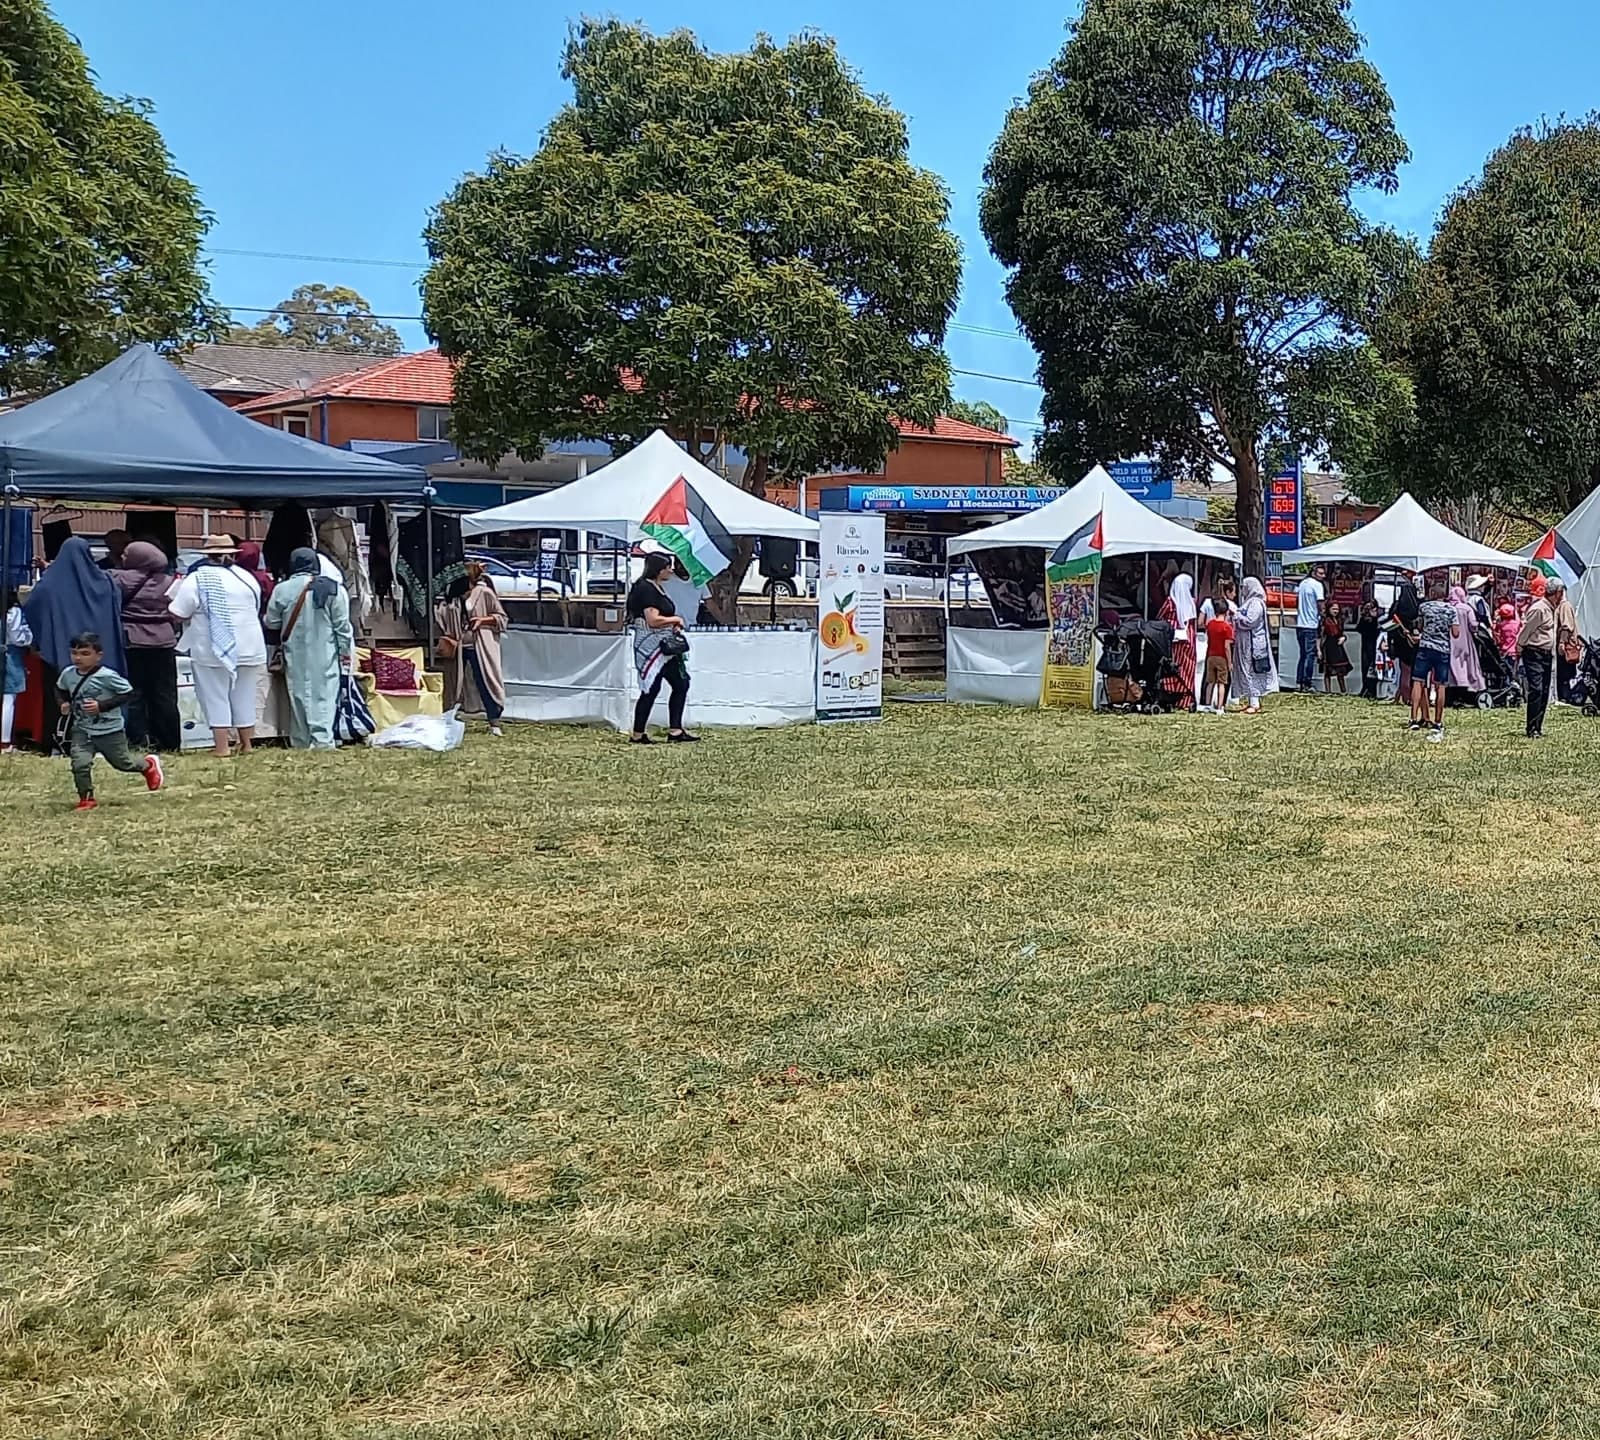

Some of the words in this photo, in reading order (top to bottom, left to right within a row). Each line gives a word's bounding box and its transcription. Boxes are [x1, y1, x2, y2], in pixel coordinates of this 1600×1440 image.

[913, 489, 970, 499] SYDNEY
[976, 489, 1030, 499] MOTOR
[947, 500, 960, 508] All
[963, 500, 1016, 508] Mechanical
